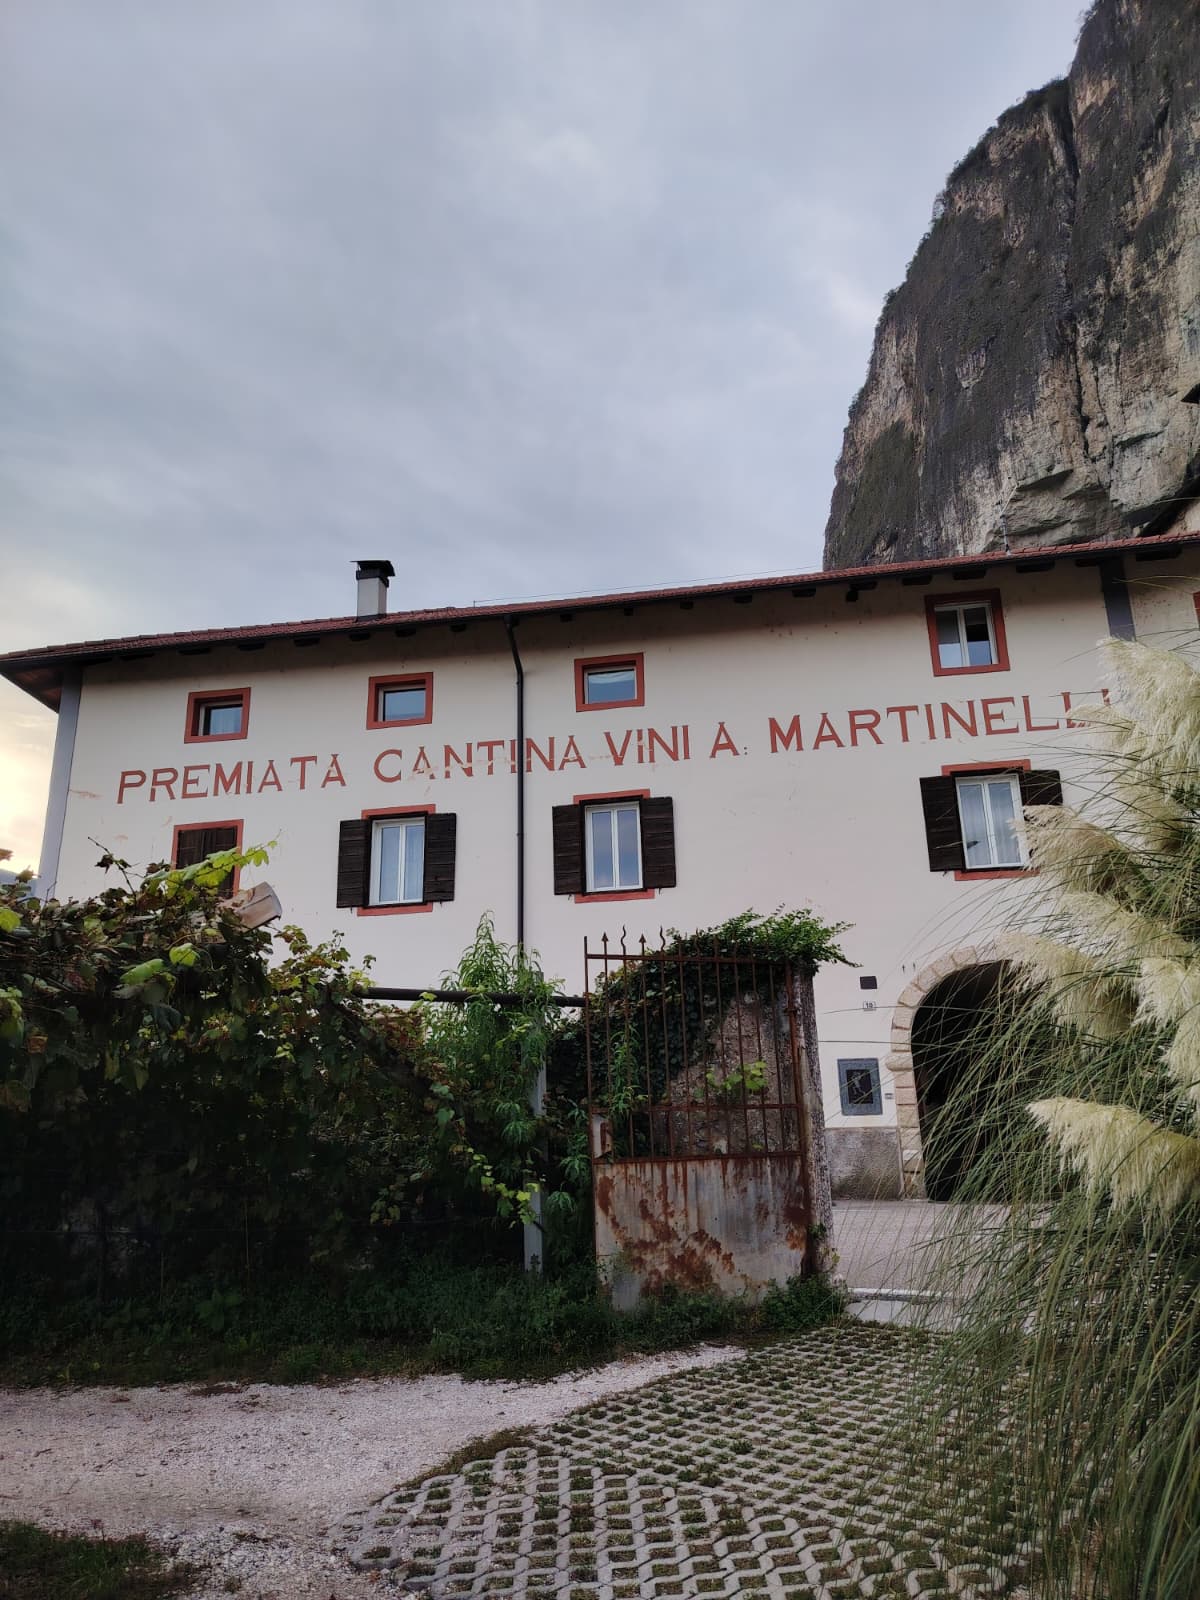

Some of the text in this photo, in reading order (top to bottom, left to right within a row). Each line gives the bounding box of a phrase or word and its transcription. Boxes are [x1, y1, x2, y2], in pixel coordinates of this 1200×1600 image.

[117, 753, 347, 804] PREMIATA
[373, 735, 587, 783] CANTINA
[603, 725, 690, 766] VINI
